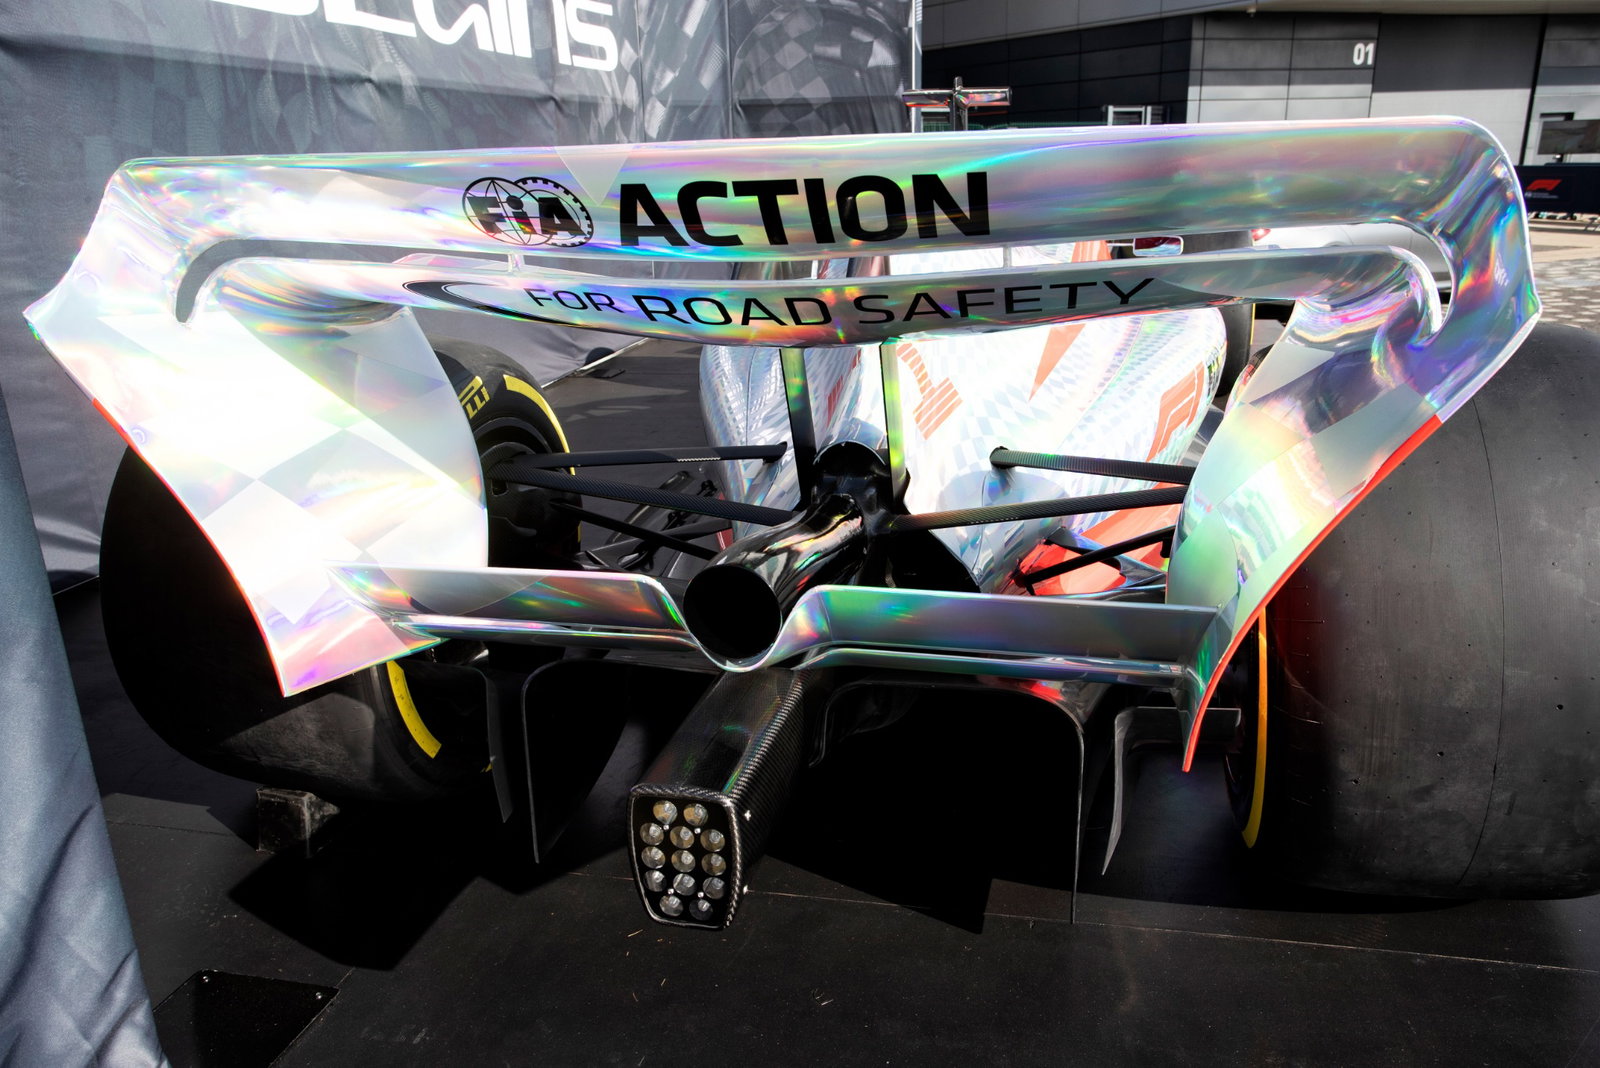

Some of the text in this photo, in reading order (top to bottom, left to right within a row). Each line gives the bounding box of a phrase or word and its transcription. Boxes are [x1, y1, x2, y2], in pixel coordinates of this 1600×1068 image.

[1353, 43, 1375, 65] 01
[620, 172, 989, 248] ACTION
[524, 278, 1155, 326] FOR ROAD SAFETY
